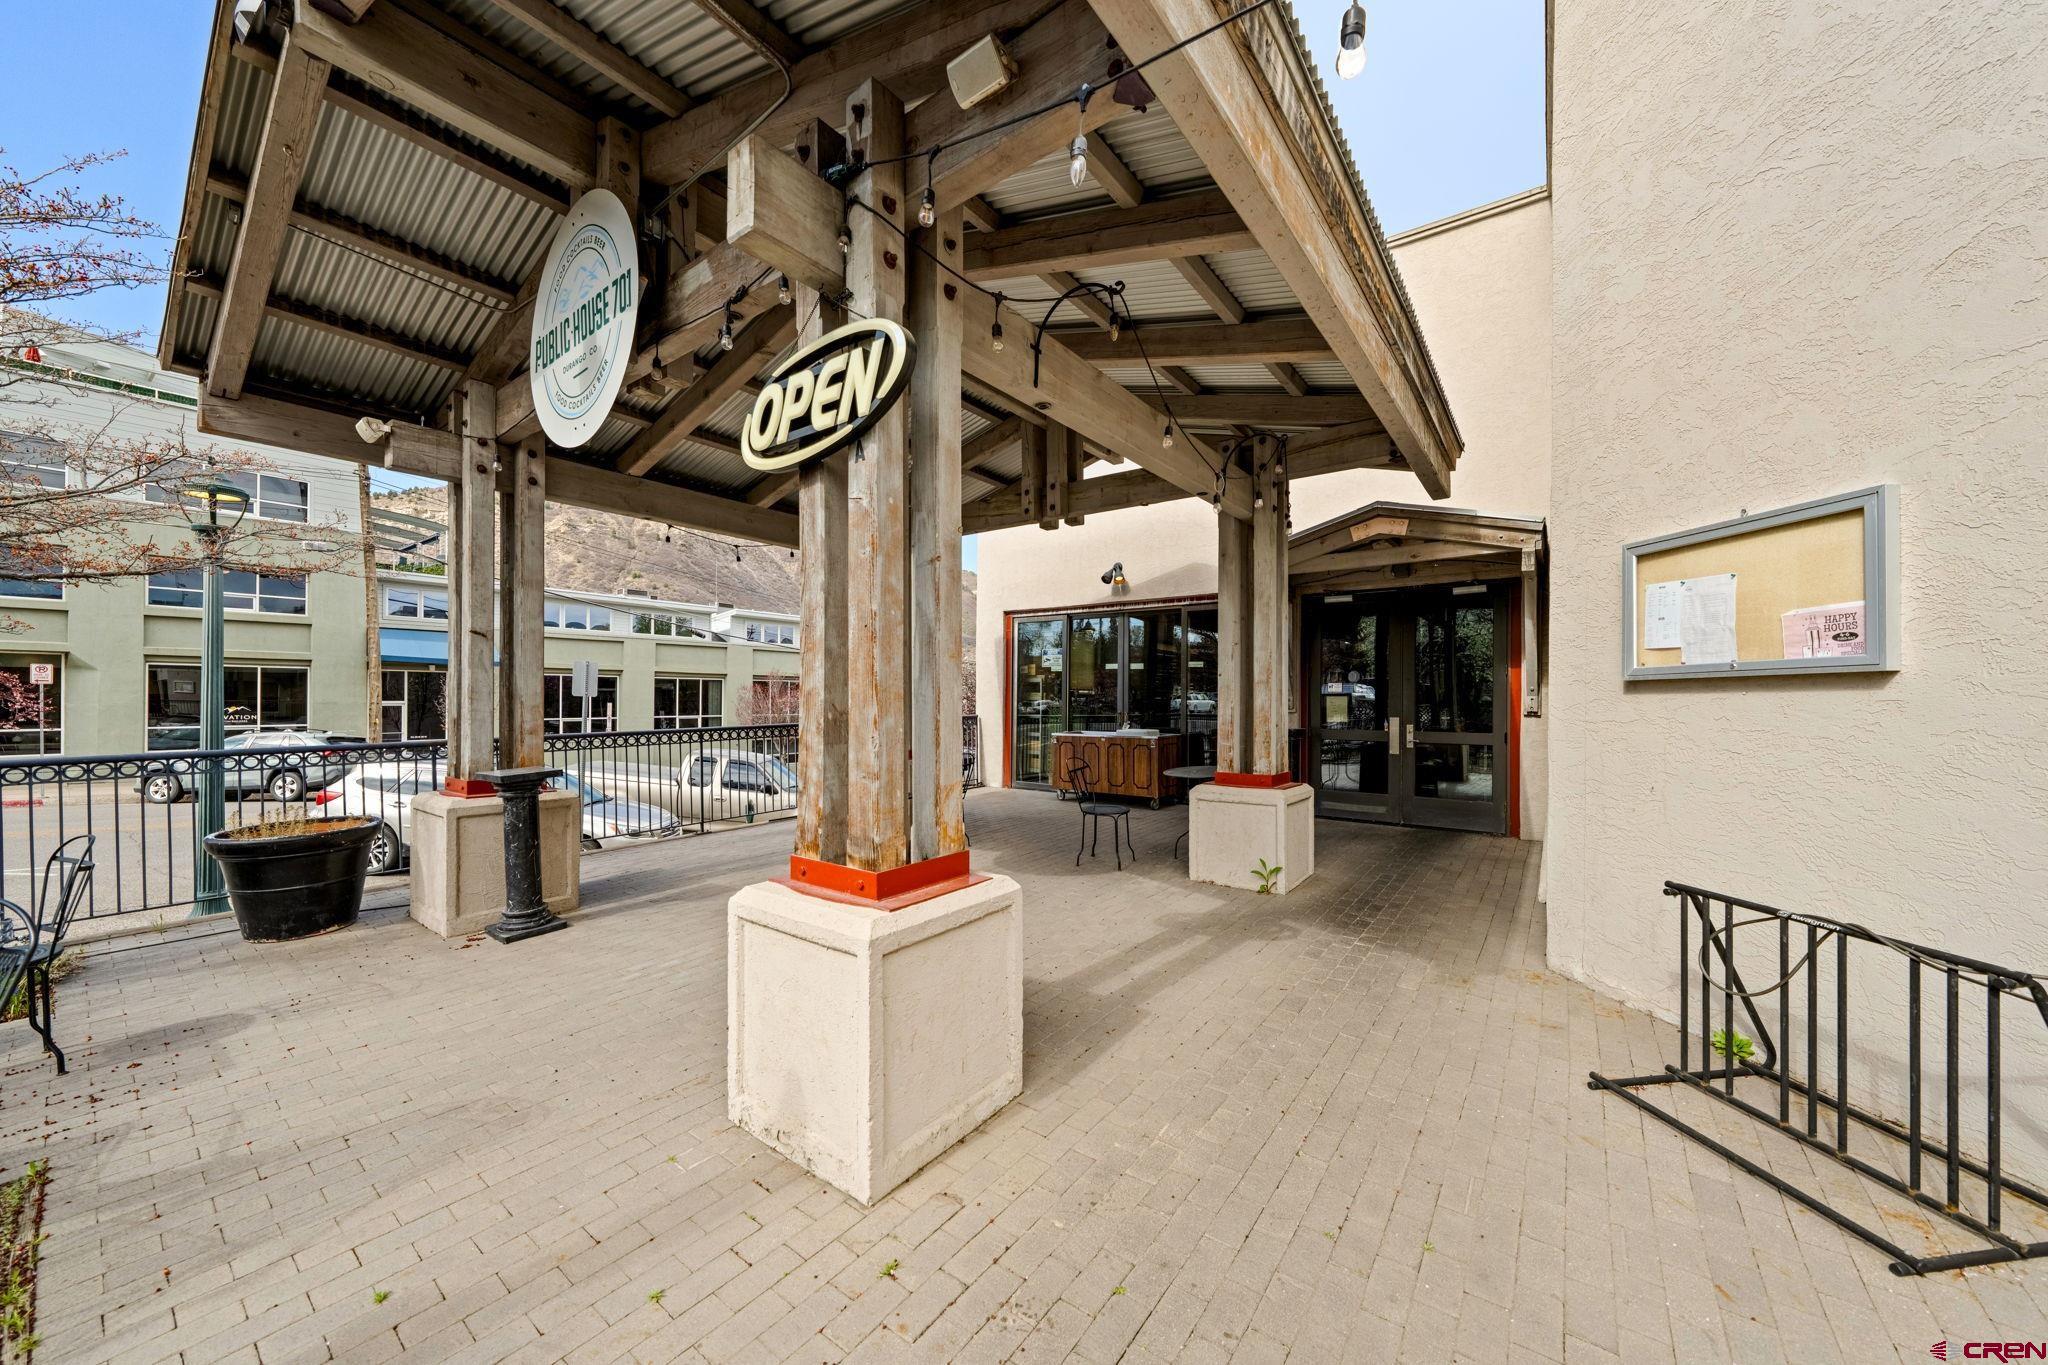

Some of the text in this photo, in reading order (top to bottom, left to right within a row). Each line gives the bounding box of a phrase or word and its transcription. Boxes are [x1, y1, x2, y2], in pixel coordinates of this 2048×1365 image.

[554, 234, 606, 293] FOOD COCKTAILS BEER
[535, 268, 632, 374] PUBLIC HOUSE 701
[562, 344, 598, 375] DURANGO CO
[555, 358, 609, 410] FOOD COCKTAILS BEER
[749, 337, 885, 451] OPEN
[1823, 621, 1858, 632] HOURS
[1824, 612, 1857, 624] HAPPY
[1790, 914, 1840, 931] swagman
